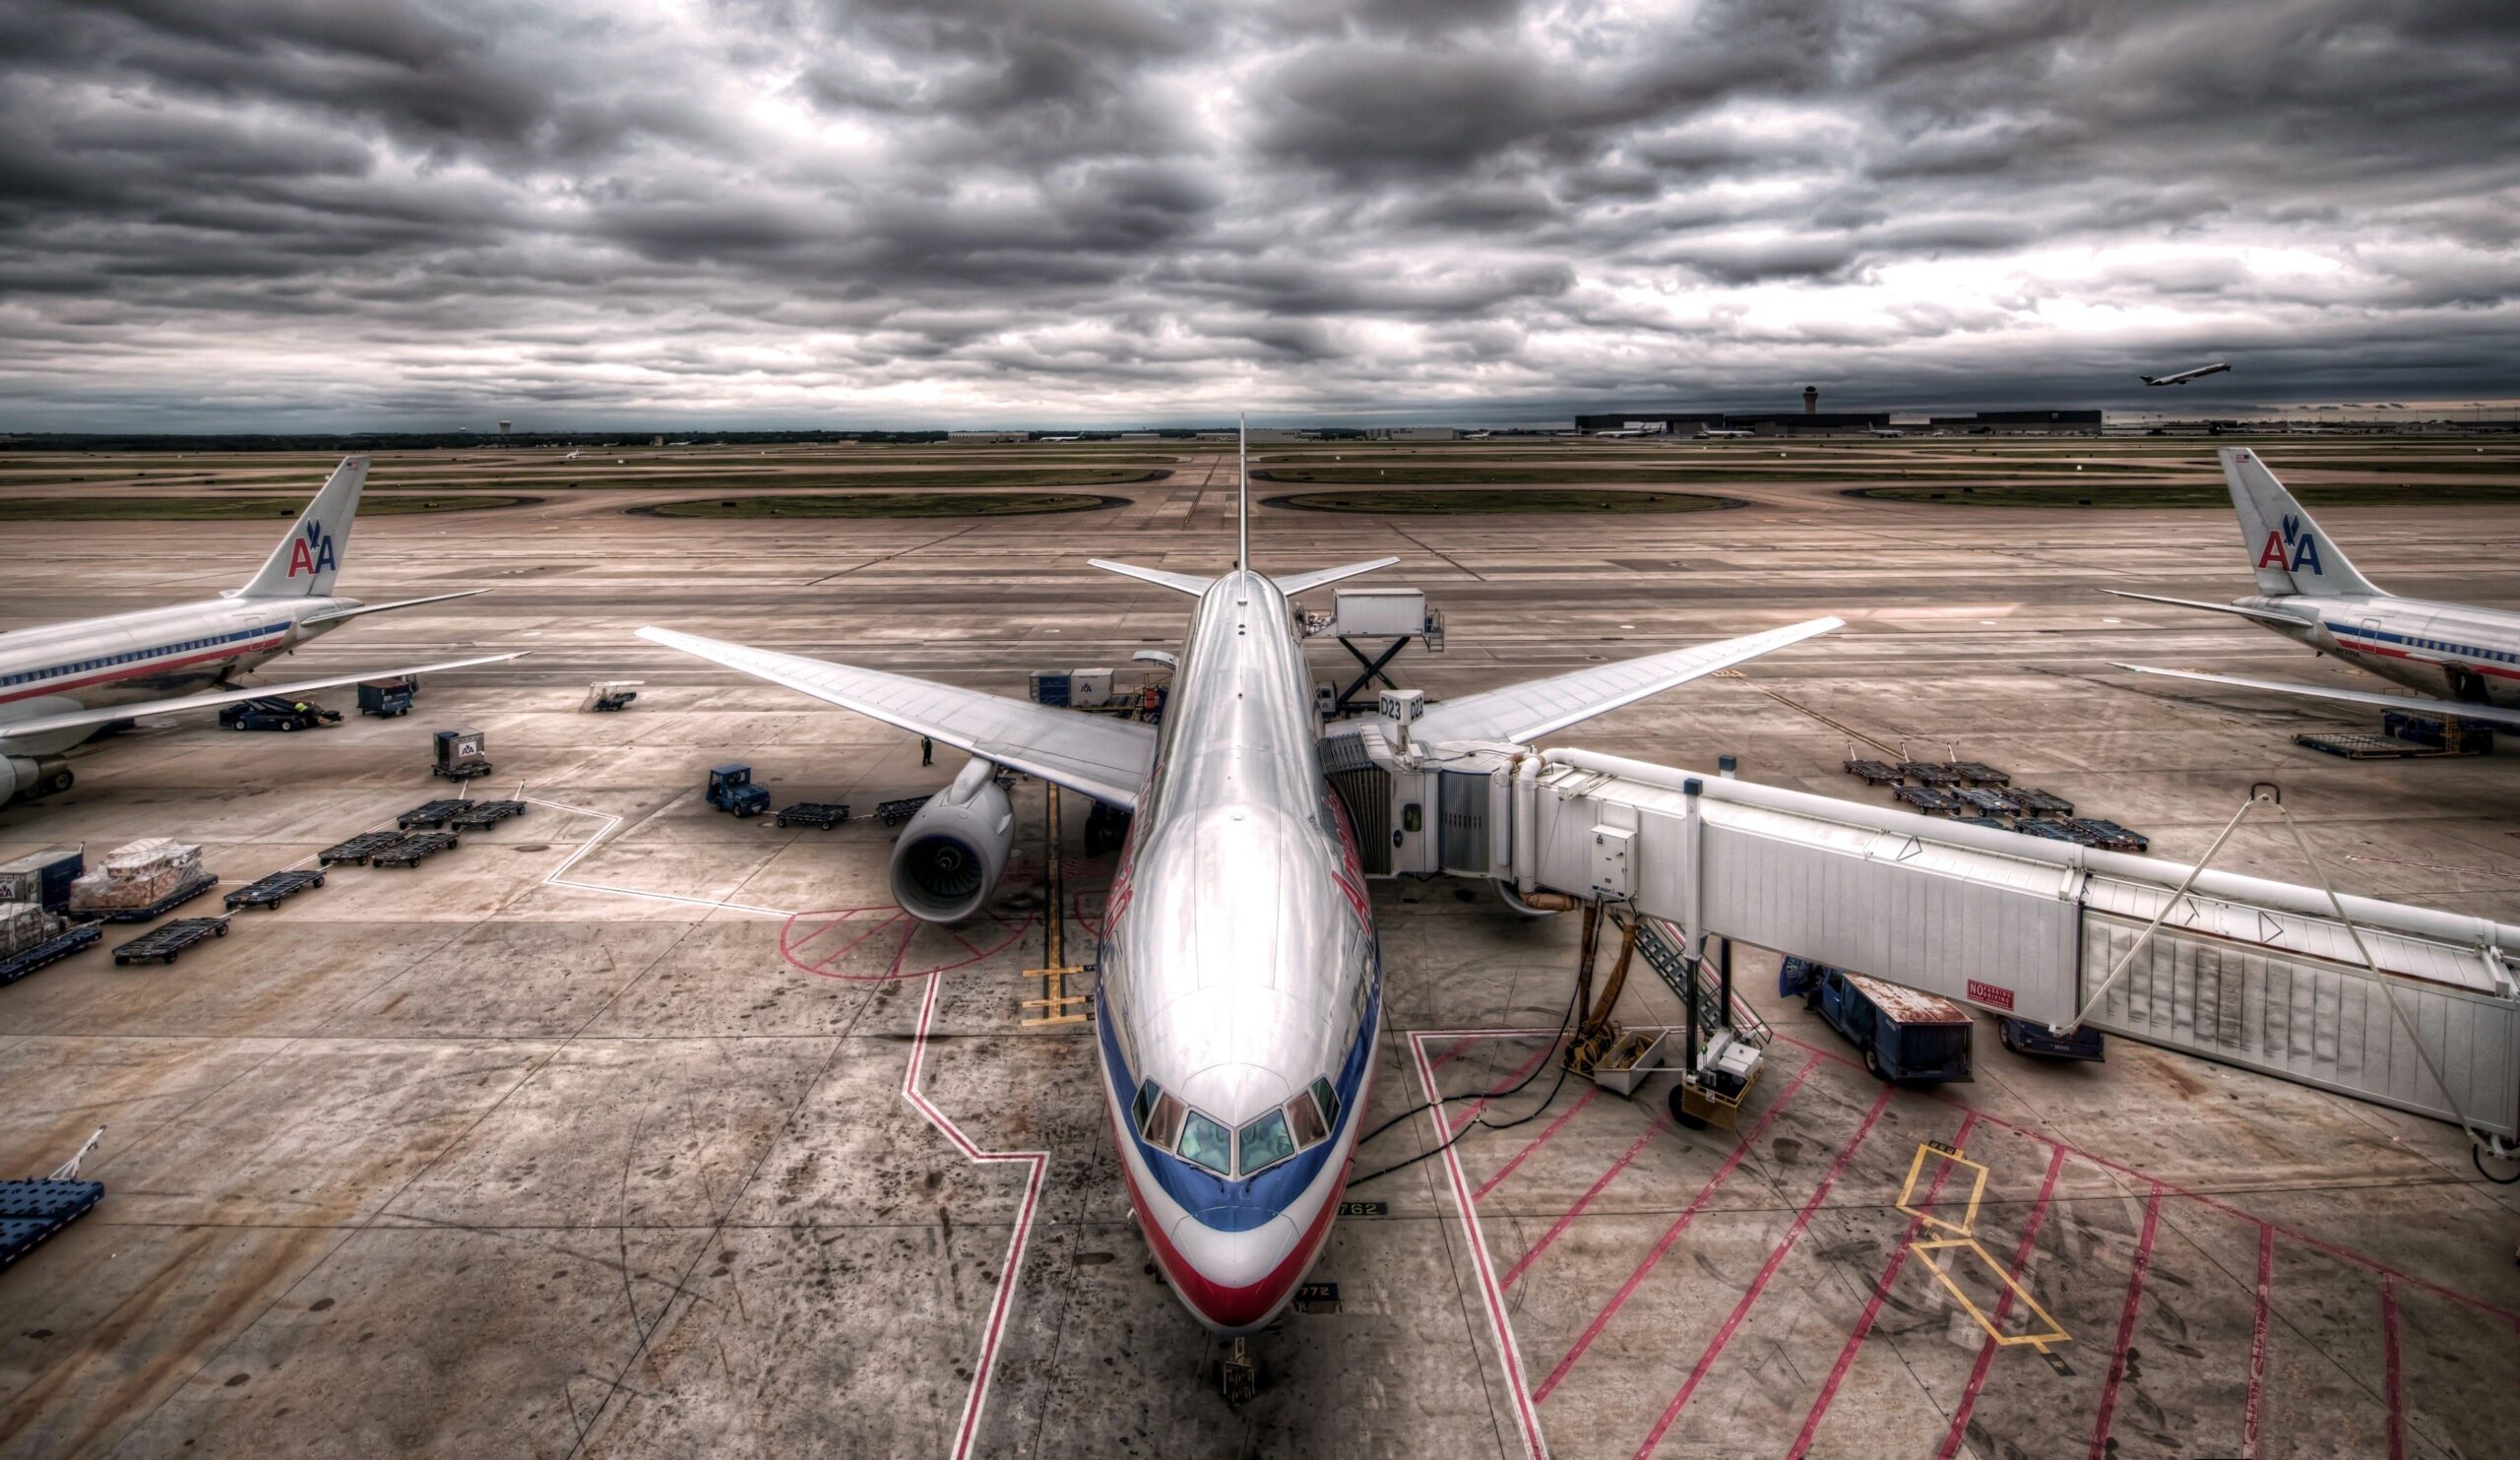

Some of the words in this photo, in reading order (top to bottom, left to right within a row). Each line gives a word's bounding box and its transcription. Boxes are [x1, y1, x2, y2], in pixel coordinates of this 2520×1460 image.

[287, 535, 337, 578] AA
[2257, 530, 2323, 576] AA
[1381, 697, 1401, 721] D23
[1411, 697, 1422, 721] D23
[462, 746, 474, 755] AA
[1970, 983, 1983, 995] NO
[1984, 986, 2011, 998] PARKING
[1984, 991, 2010, 1003] DRIVING
[1341, 1203, 1377, 1215] 762
[1299, 1286, 1330, 1296] 772
